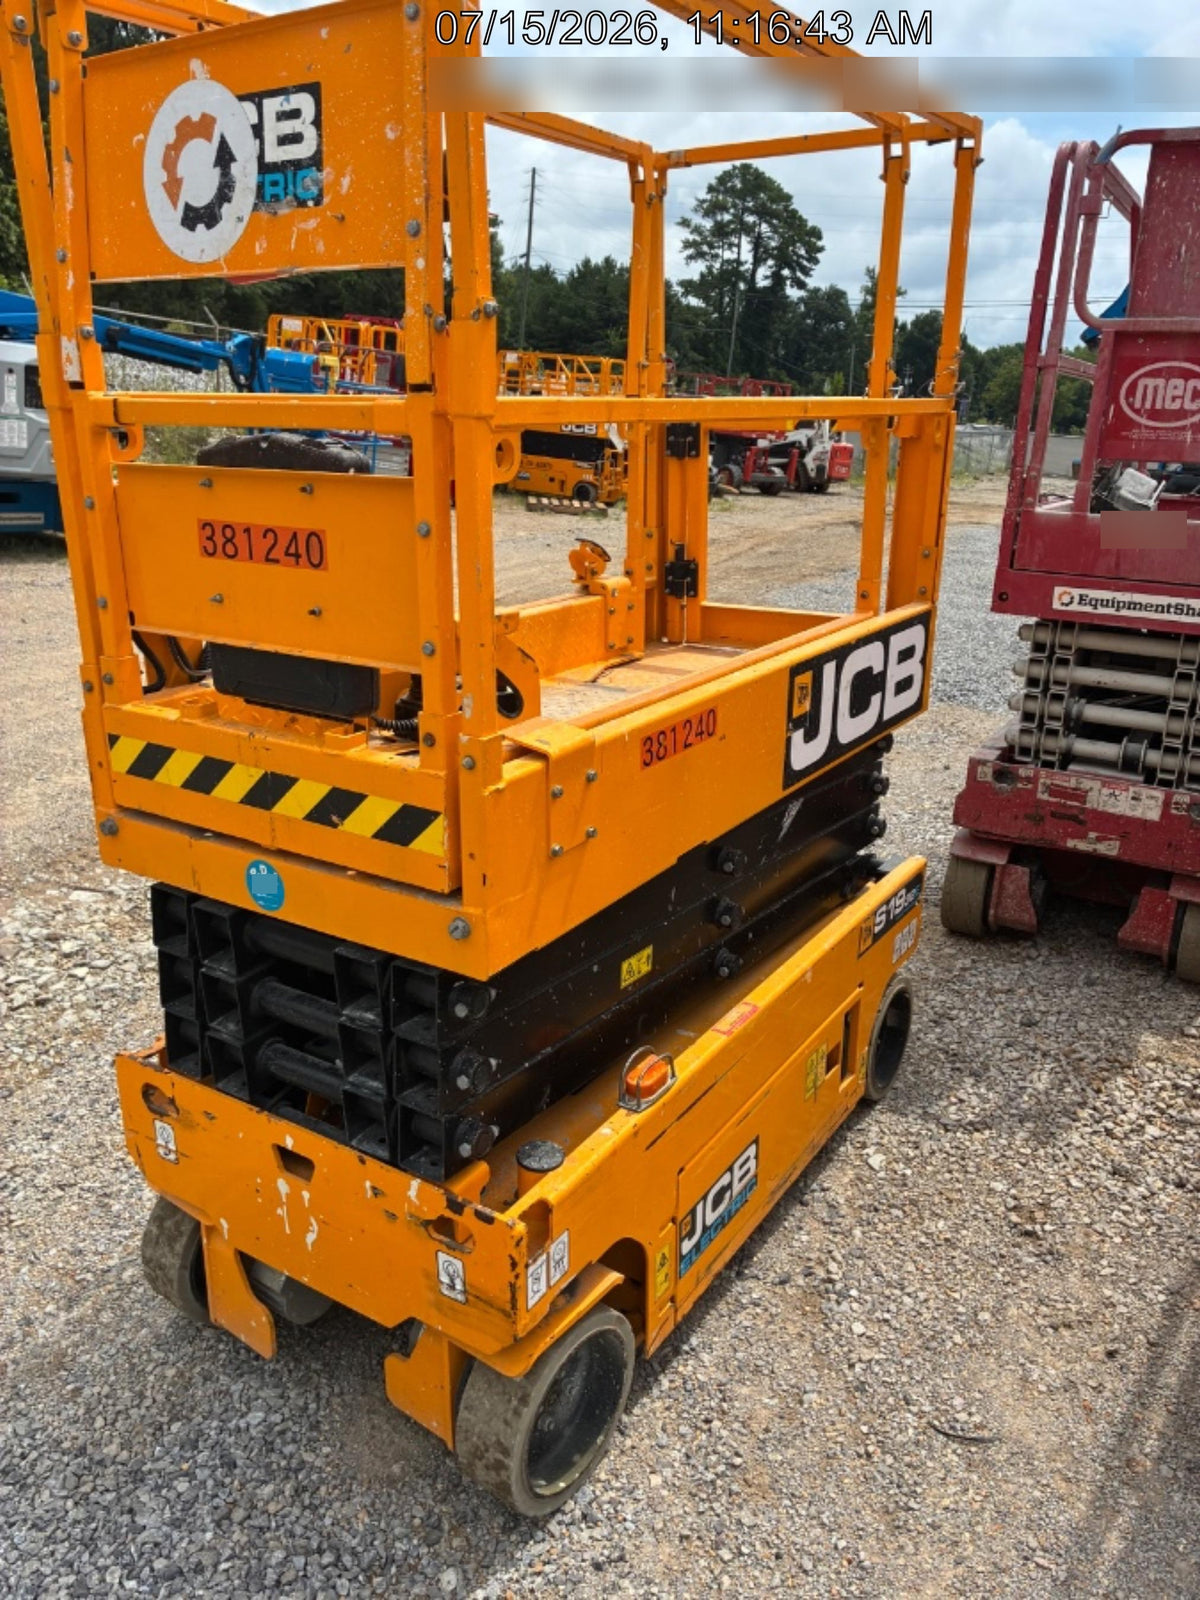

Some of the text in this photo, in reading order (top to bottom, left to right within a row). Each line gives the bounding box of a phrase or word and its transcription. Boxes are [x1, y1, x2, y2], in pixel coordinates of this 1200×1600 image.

[201, 521, 324, 569] 381240
[642, 708, 717, 768] 381240
[790, 623, 926, 771] JCB
[680, 1142, 757, 1256] JCB
[680, 1176, 758, 1279] ELECTRIC
